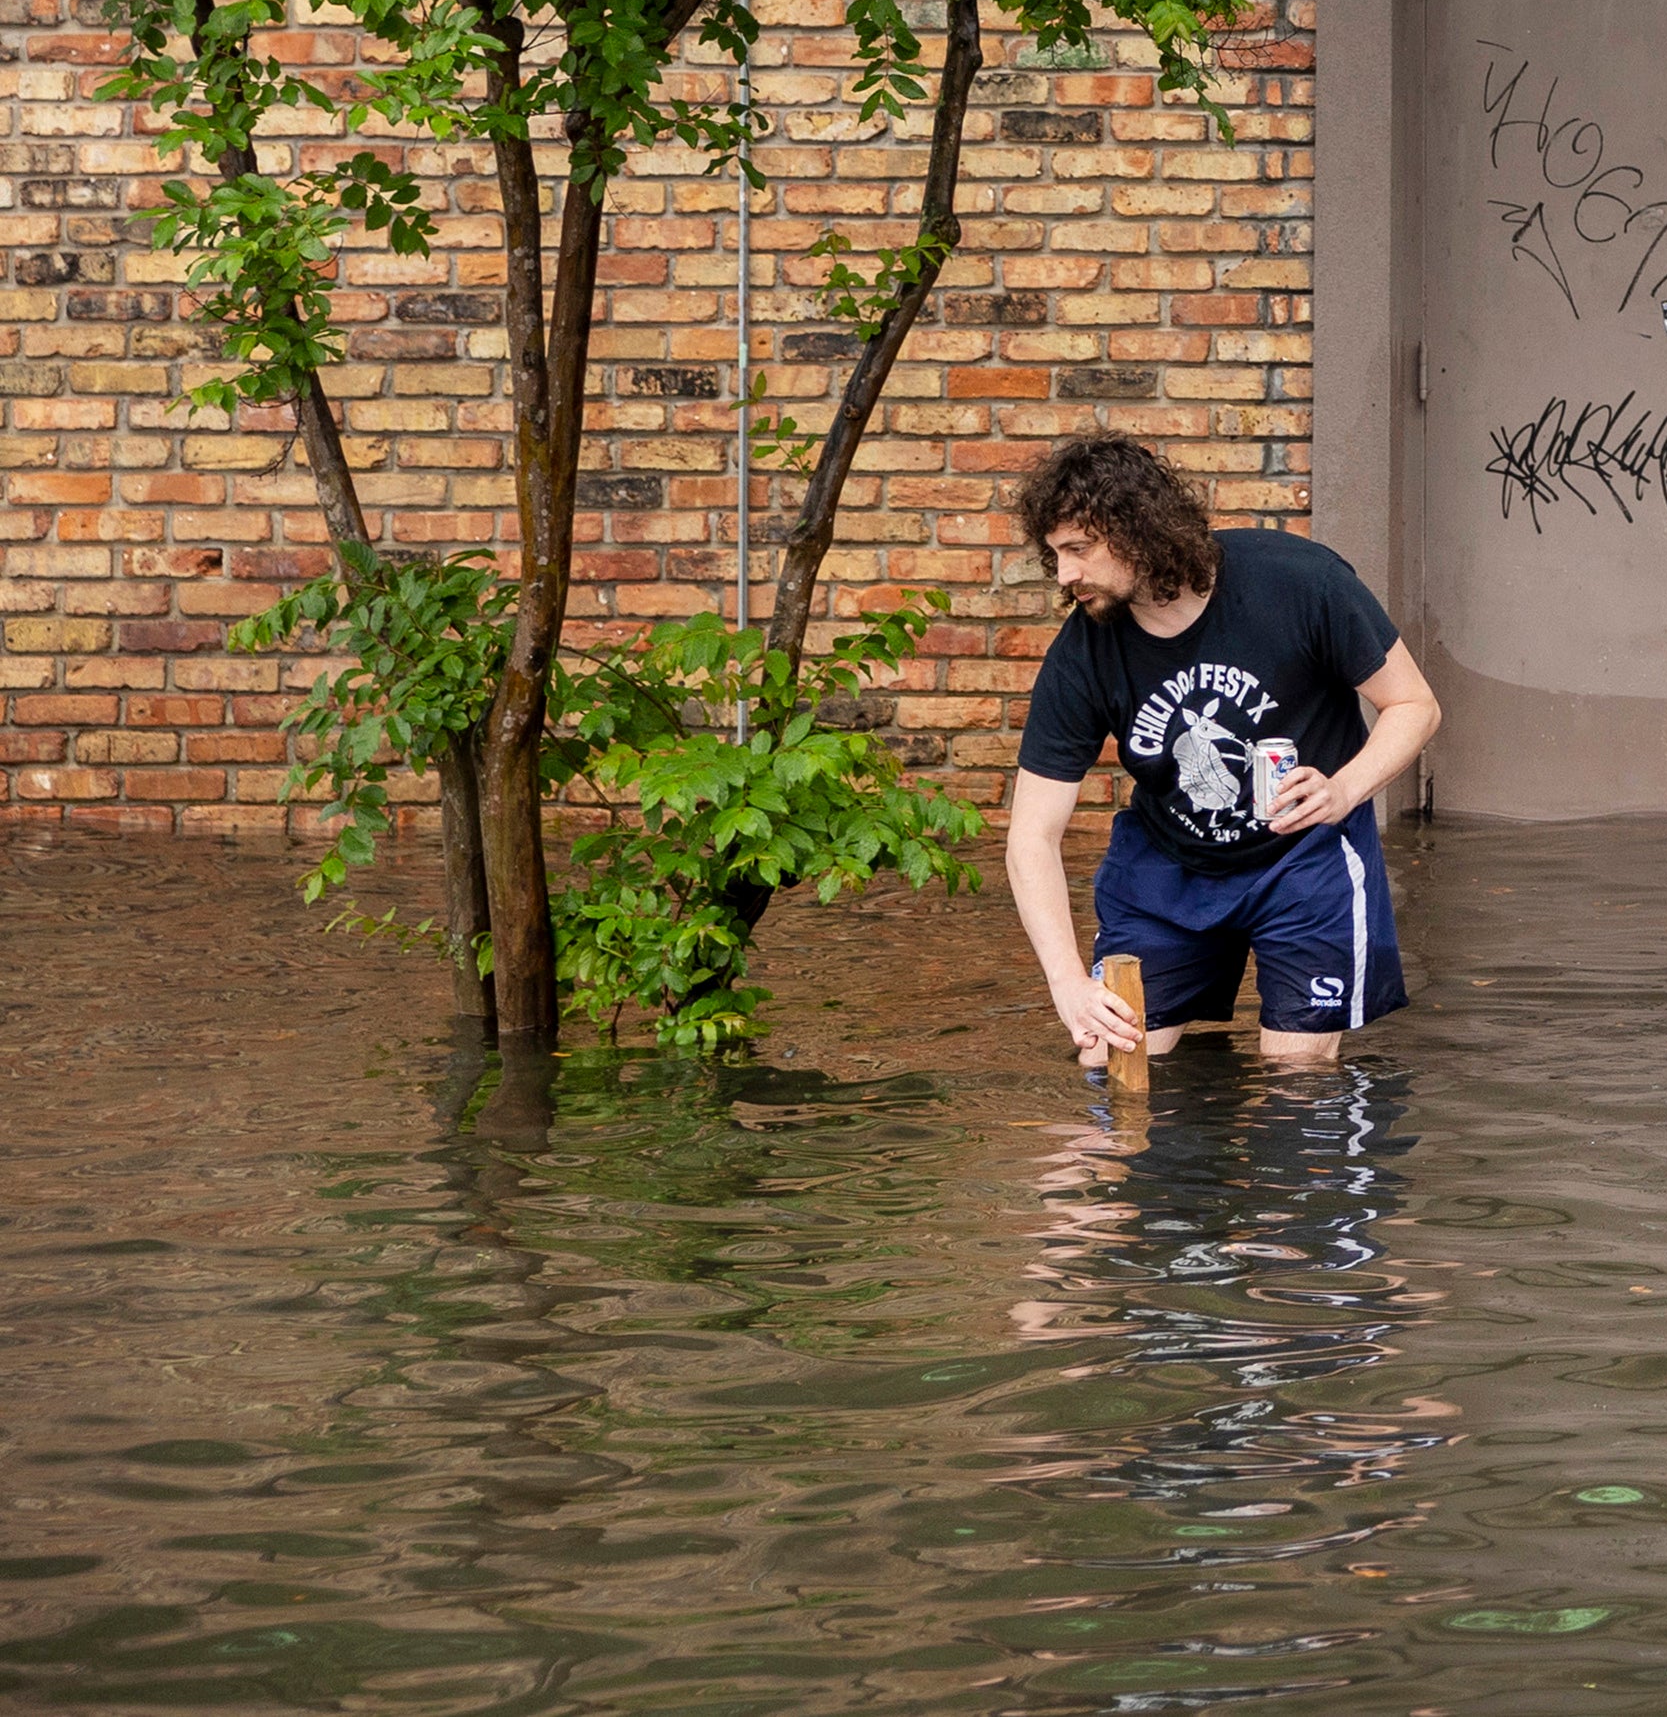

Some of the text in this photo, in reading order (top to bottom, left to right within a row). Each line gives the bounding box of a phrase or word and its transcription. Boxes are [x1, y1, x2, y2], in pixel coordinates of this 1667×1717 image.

[1129, 693, 1175, 756] CHILI
[1200, 663, 1260, 707] FEST
[1246, 692, 1279, 725] X
